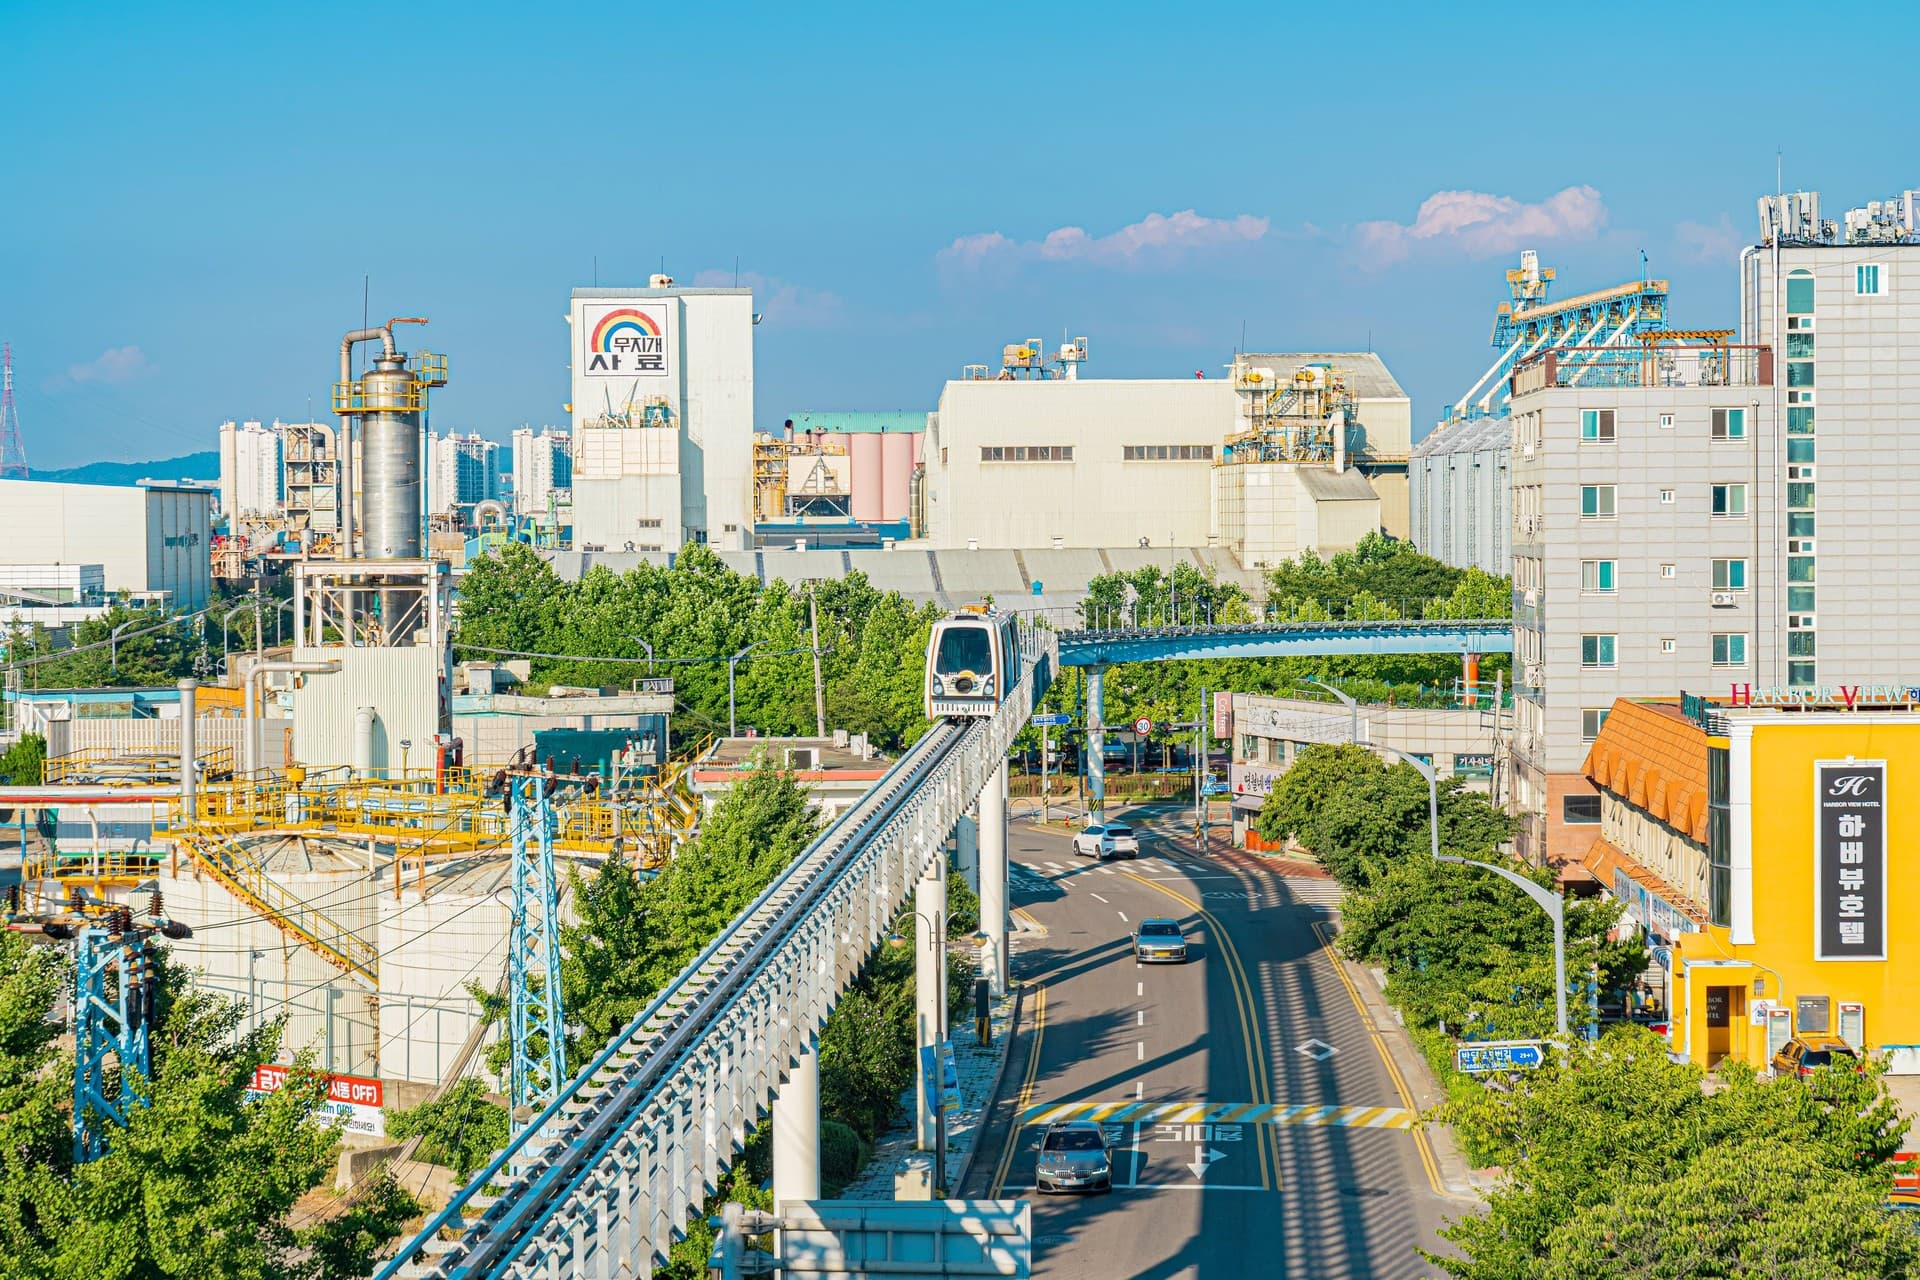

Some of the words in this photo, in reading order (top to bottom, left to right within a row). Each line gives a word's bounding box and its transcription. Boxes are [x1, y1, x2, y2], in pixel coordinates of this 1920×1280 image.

[614, 337, 662, 353] 무지개
[1138, 722, 1149, 731] 30
[1838, 814, 1867, 944] 하버뷰호텔
[330, 1080, 350, 1099] 시동
[352, 1084, 377, 1103] OFF)
